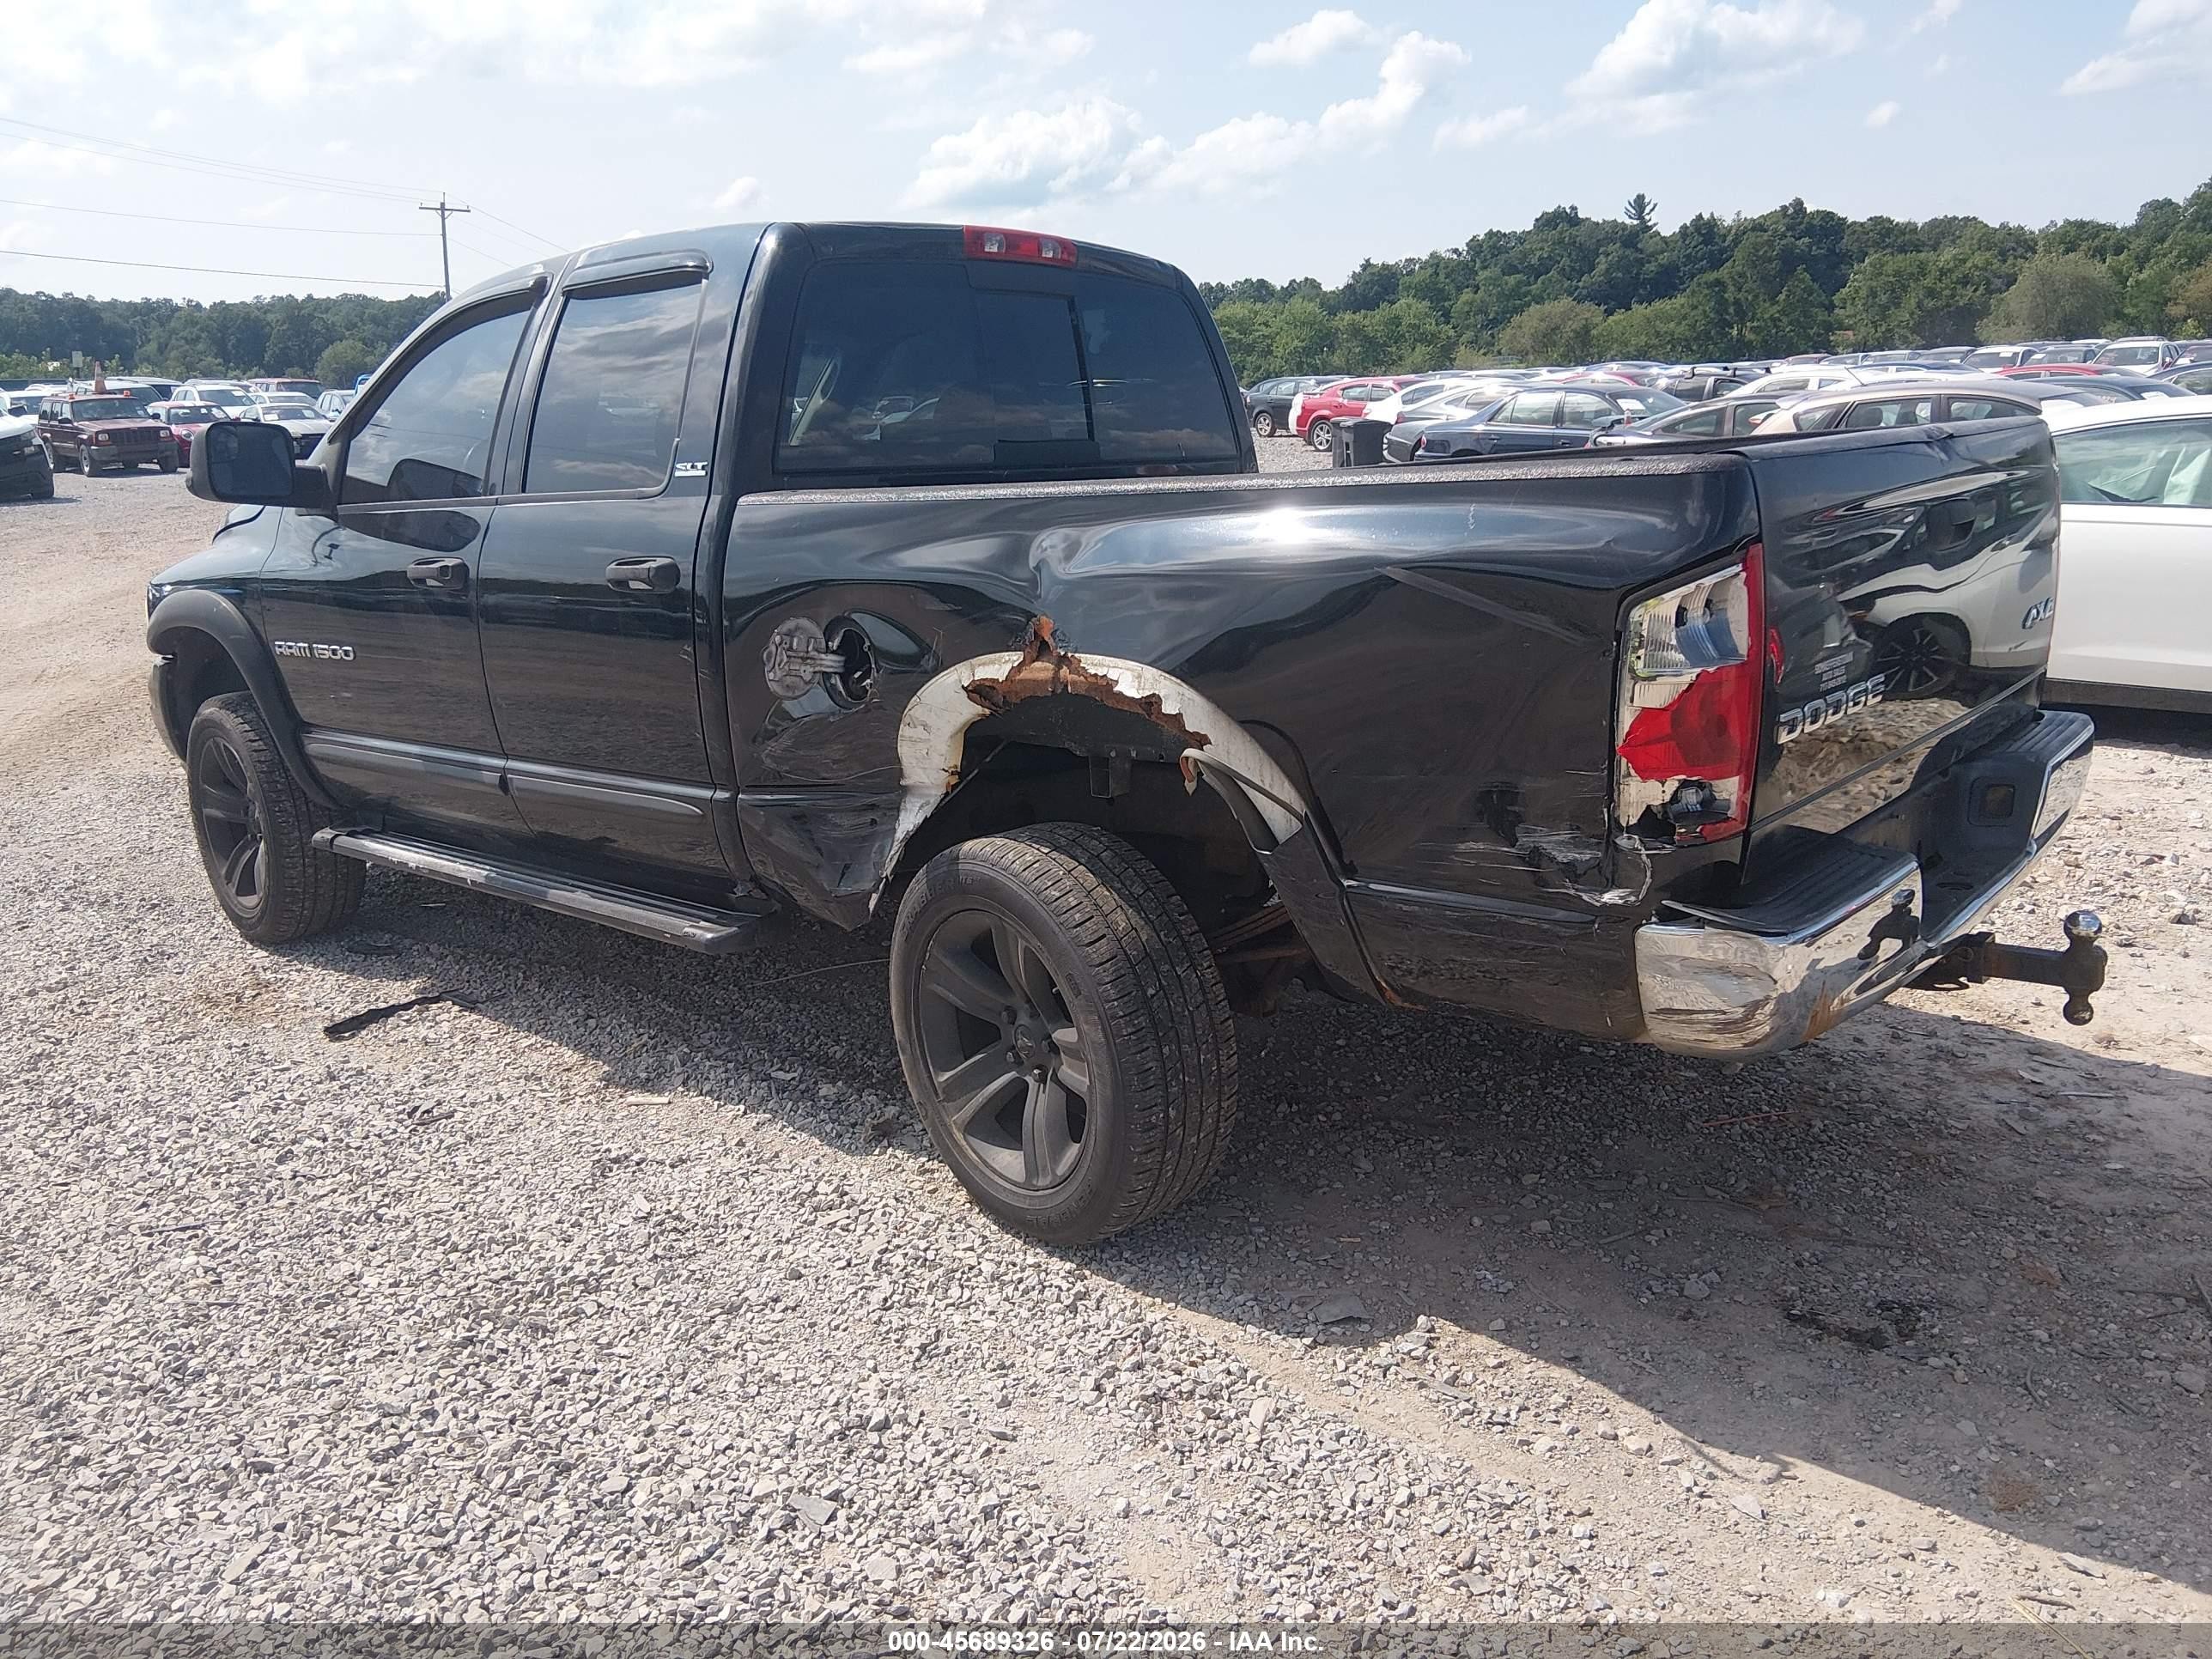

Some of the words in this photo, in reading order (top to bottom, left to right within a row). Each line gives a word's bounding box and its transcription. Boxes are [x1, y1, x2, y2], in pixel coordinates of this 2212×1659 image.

[676, 461, 708, 471] SLT
[274, 641, 311, 659] RAM
[313, 643, 356, 661] 1500
[1777, 674, 1887, 744] DODGE
